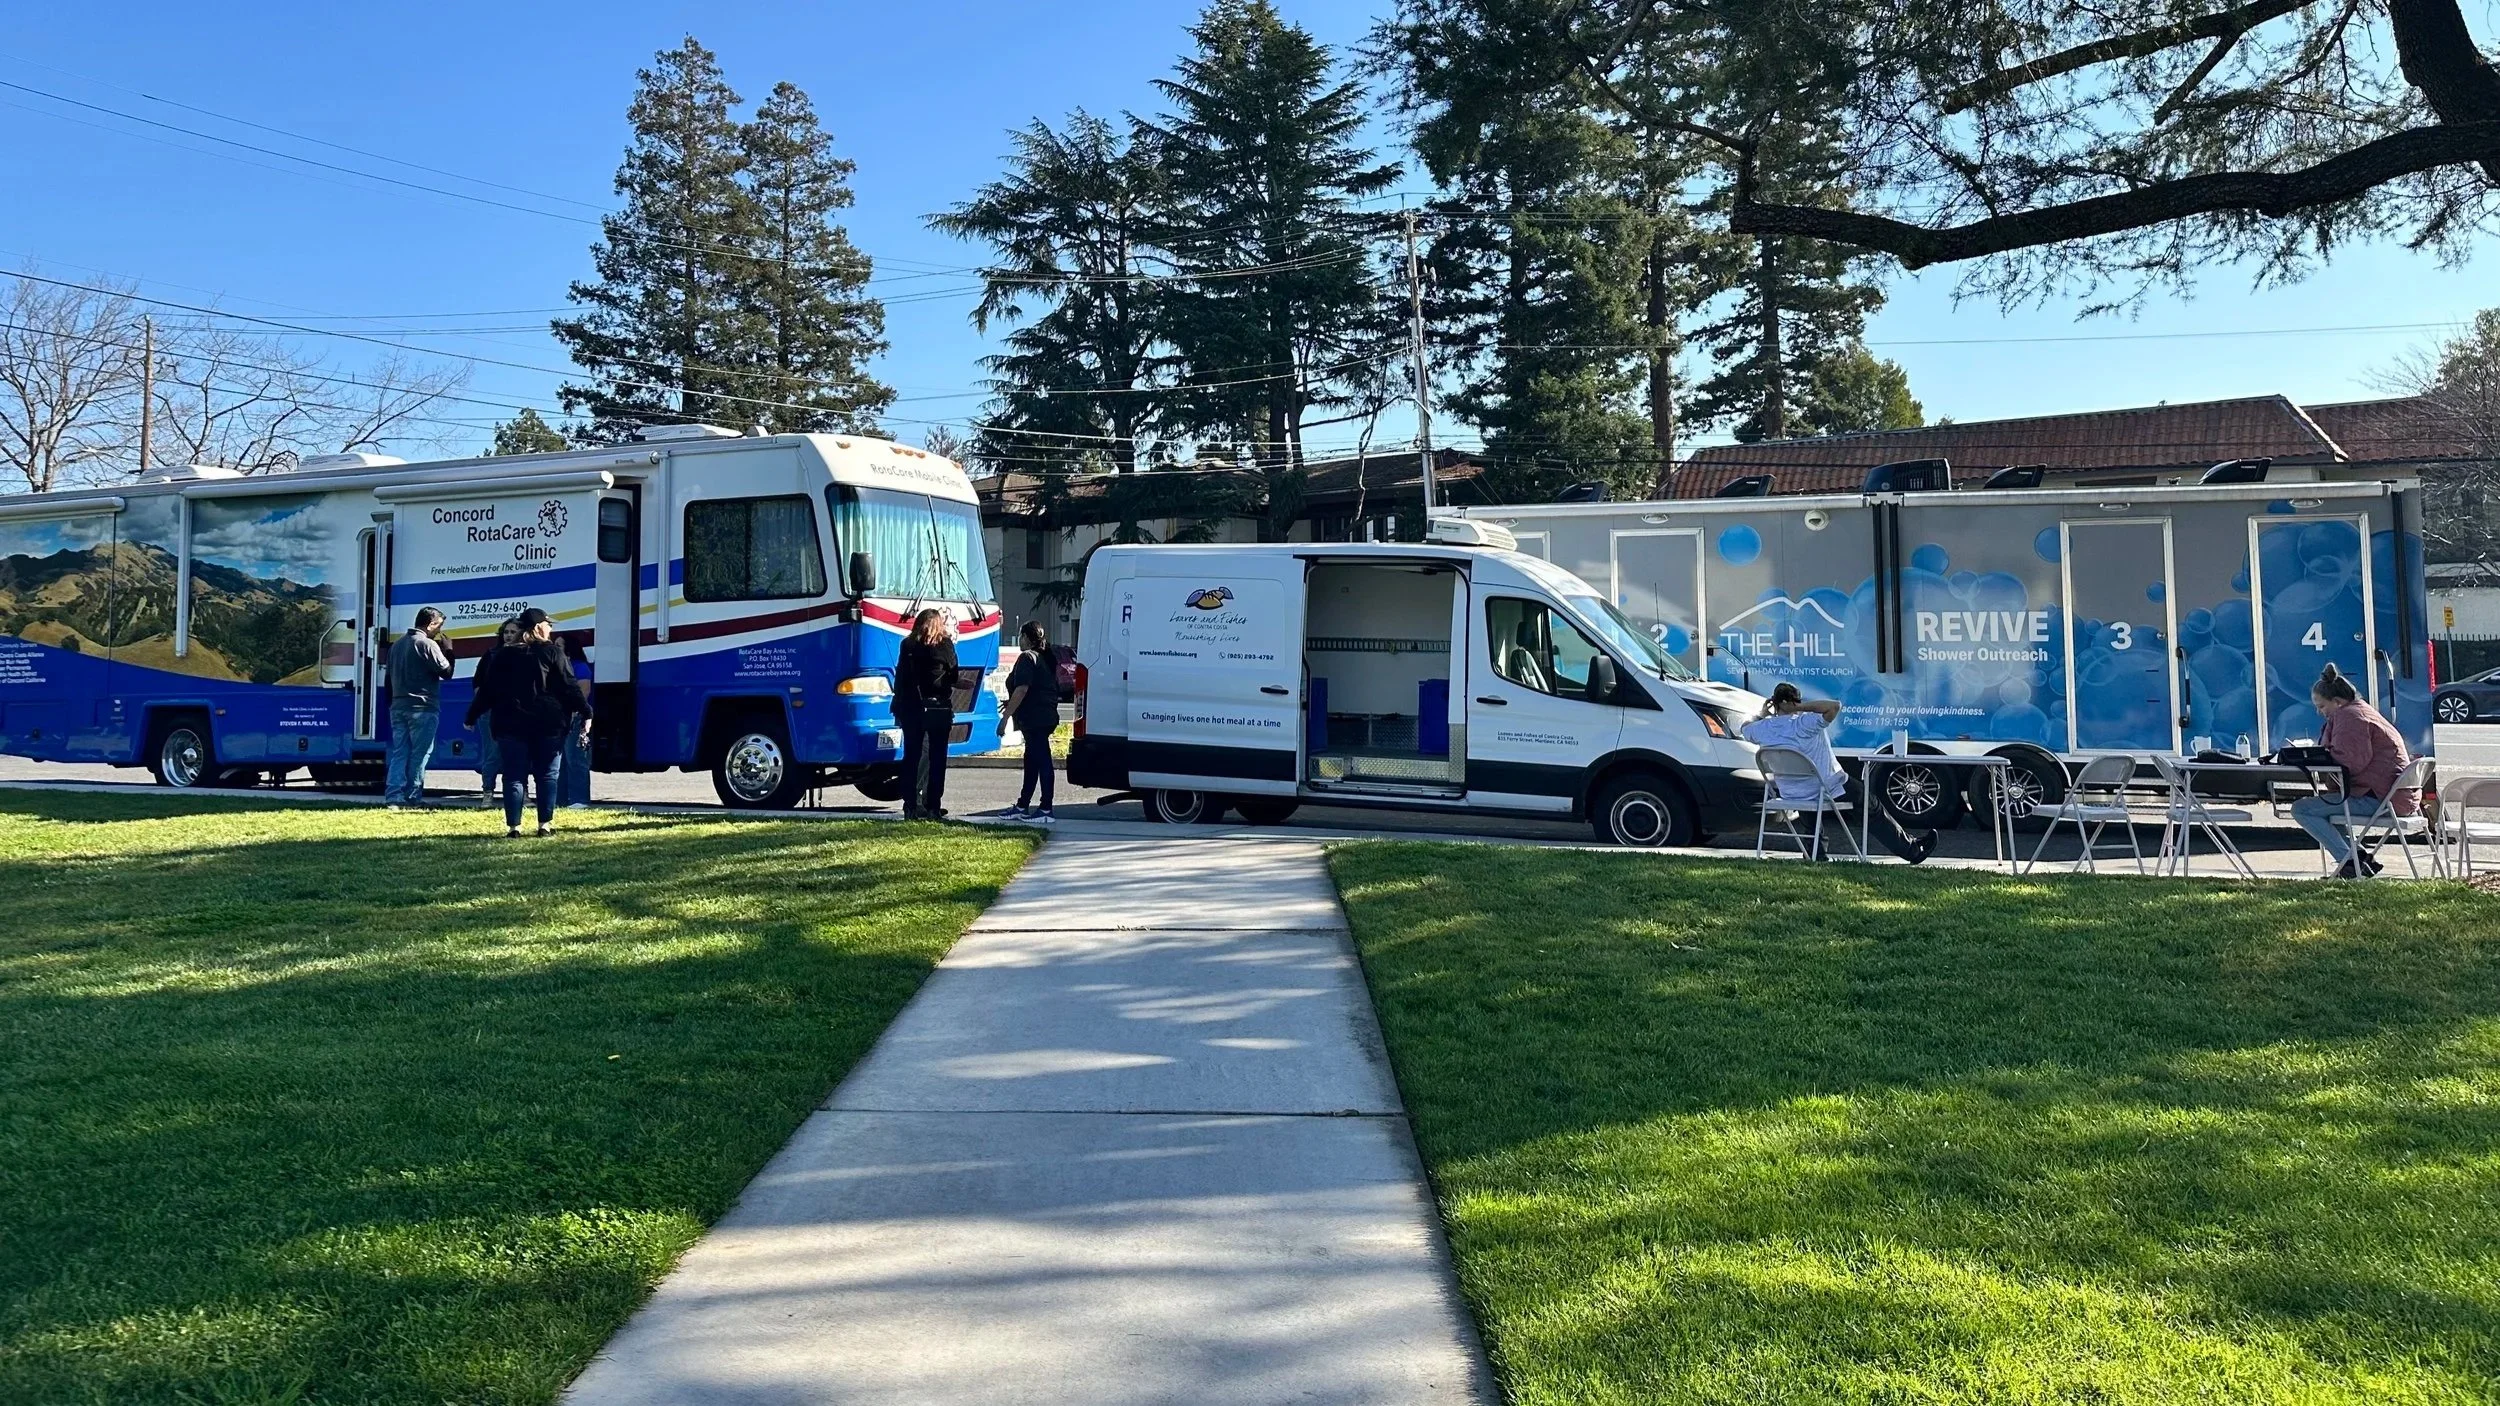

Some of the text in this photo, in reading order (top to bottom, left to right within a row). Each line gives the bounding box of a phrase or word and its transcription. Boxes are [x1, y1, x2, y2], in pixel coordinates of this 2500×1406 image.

[870, 463, 914, 478] RotaCare
[914, 468, 942, 484] Mobile
[432, 504, 495, 524] Concord
[467, 524, 535, 542] RotaCare
[514, 543, 557, 560] Clinic
[431, 560, 552, 575] Free Health Care For The Uninsured
[458, 601, 528, 614] 925-429-6409
[451, 612, 522, 620] www.rotacarebayarea.
[1169, 611, 1248, 624] Loaves and Fishes
[1916, 611, 2050, 642] REVIVE
[1650, 623, 1669, 649] 2
[2110, 621, 2133, 650] 3
[2301, 622, 2328, 651] 4
[1720, 625, 1846, 667] THE HILL
[1917, 647, 2048, 661] Shower Outreach
[1726, 658, 1781, 666] PLEASANT HILL
[1779, 667, 1820, 675] ADVENTIST
[1821, 667, 1854, 675] CHURCH
[1841, 704, 1986, 717] according to your lovingkindness.
[1141, 711, 1175, 723] Changing
[1177, 713, 1195, 722] lives
[1196, 715, 1210, 723] one
[1211, 715, 1225, 724] hot
[1226, 716, 1245, 725] meal
[1246, 718, 1255, 726] at
[1263, 718, 1281, 727] time
[1843, 716, 1910, 727] Psalms 119:159
